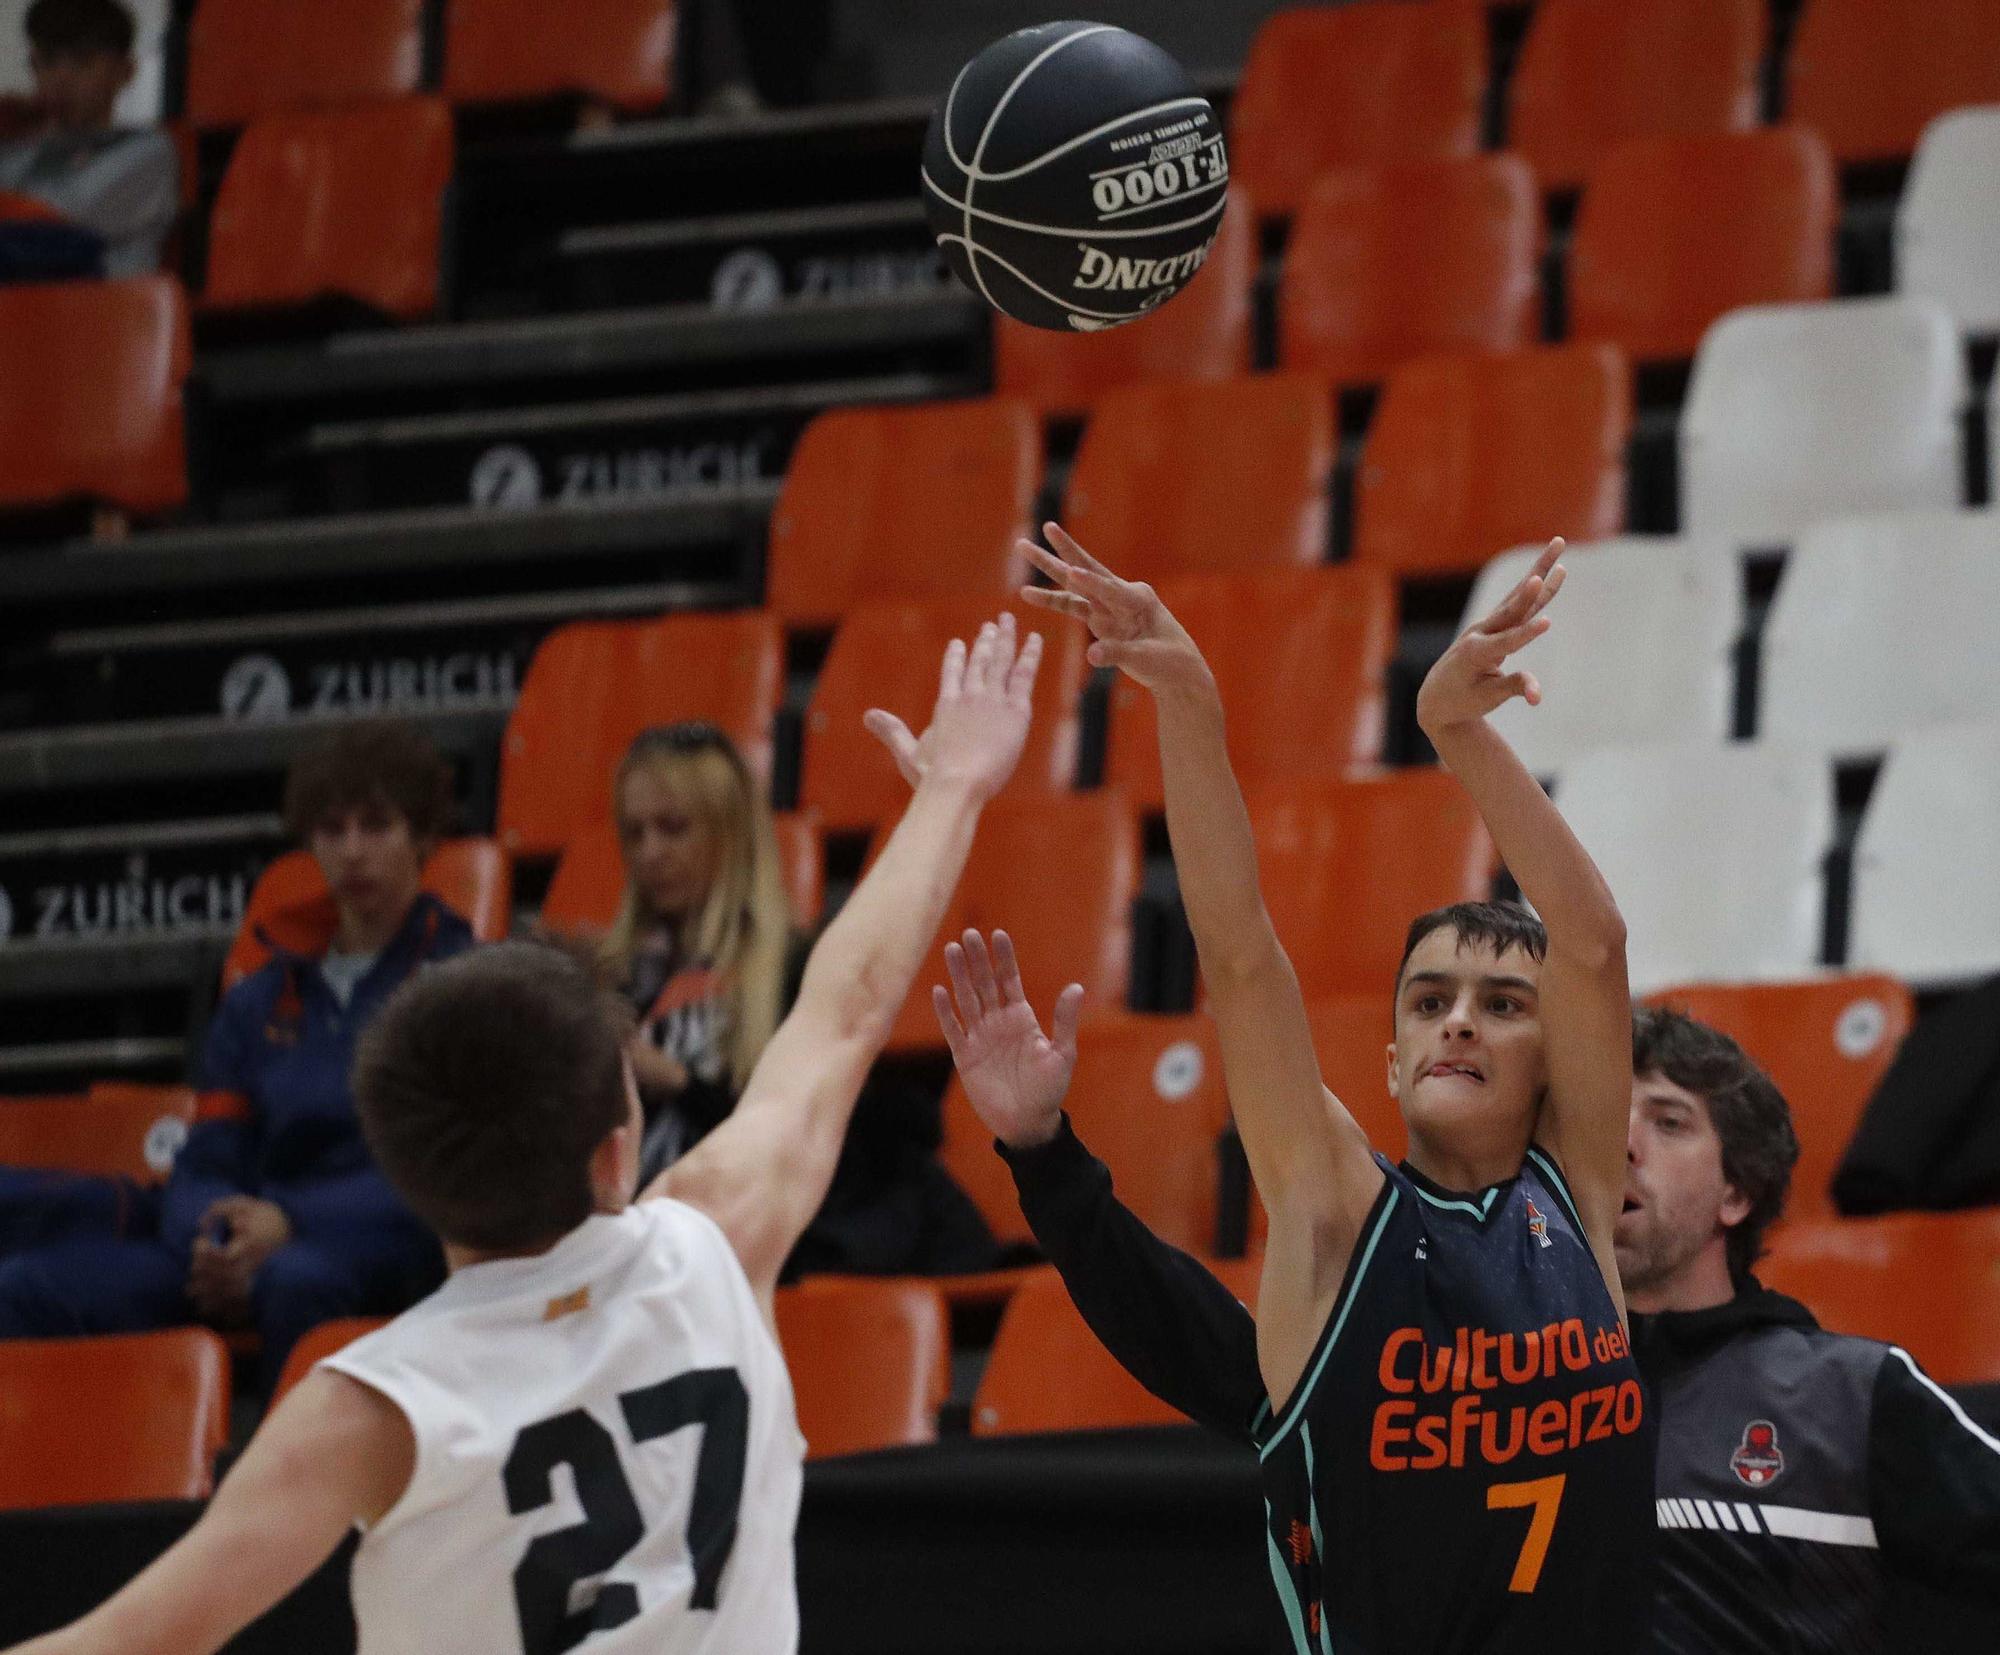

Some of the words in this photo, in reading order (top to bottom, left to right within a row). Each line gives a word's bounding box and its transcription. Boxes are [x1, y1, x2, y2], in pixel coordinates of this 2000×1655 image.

[32, 874, 243, 938] ZURICH
[1378, 1318, 1591, 1393] Cultura
[1370, 1379, 1643, 1471] Esfuerzo
[503, 1366, 750, 1655] 27
[1486, 1473, 1567, 1593] 7
